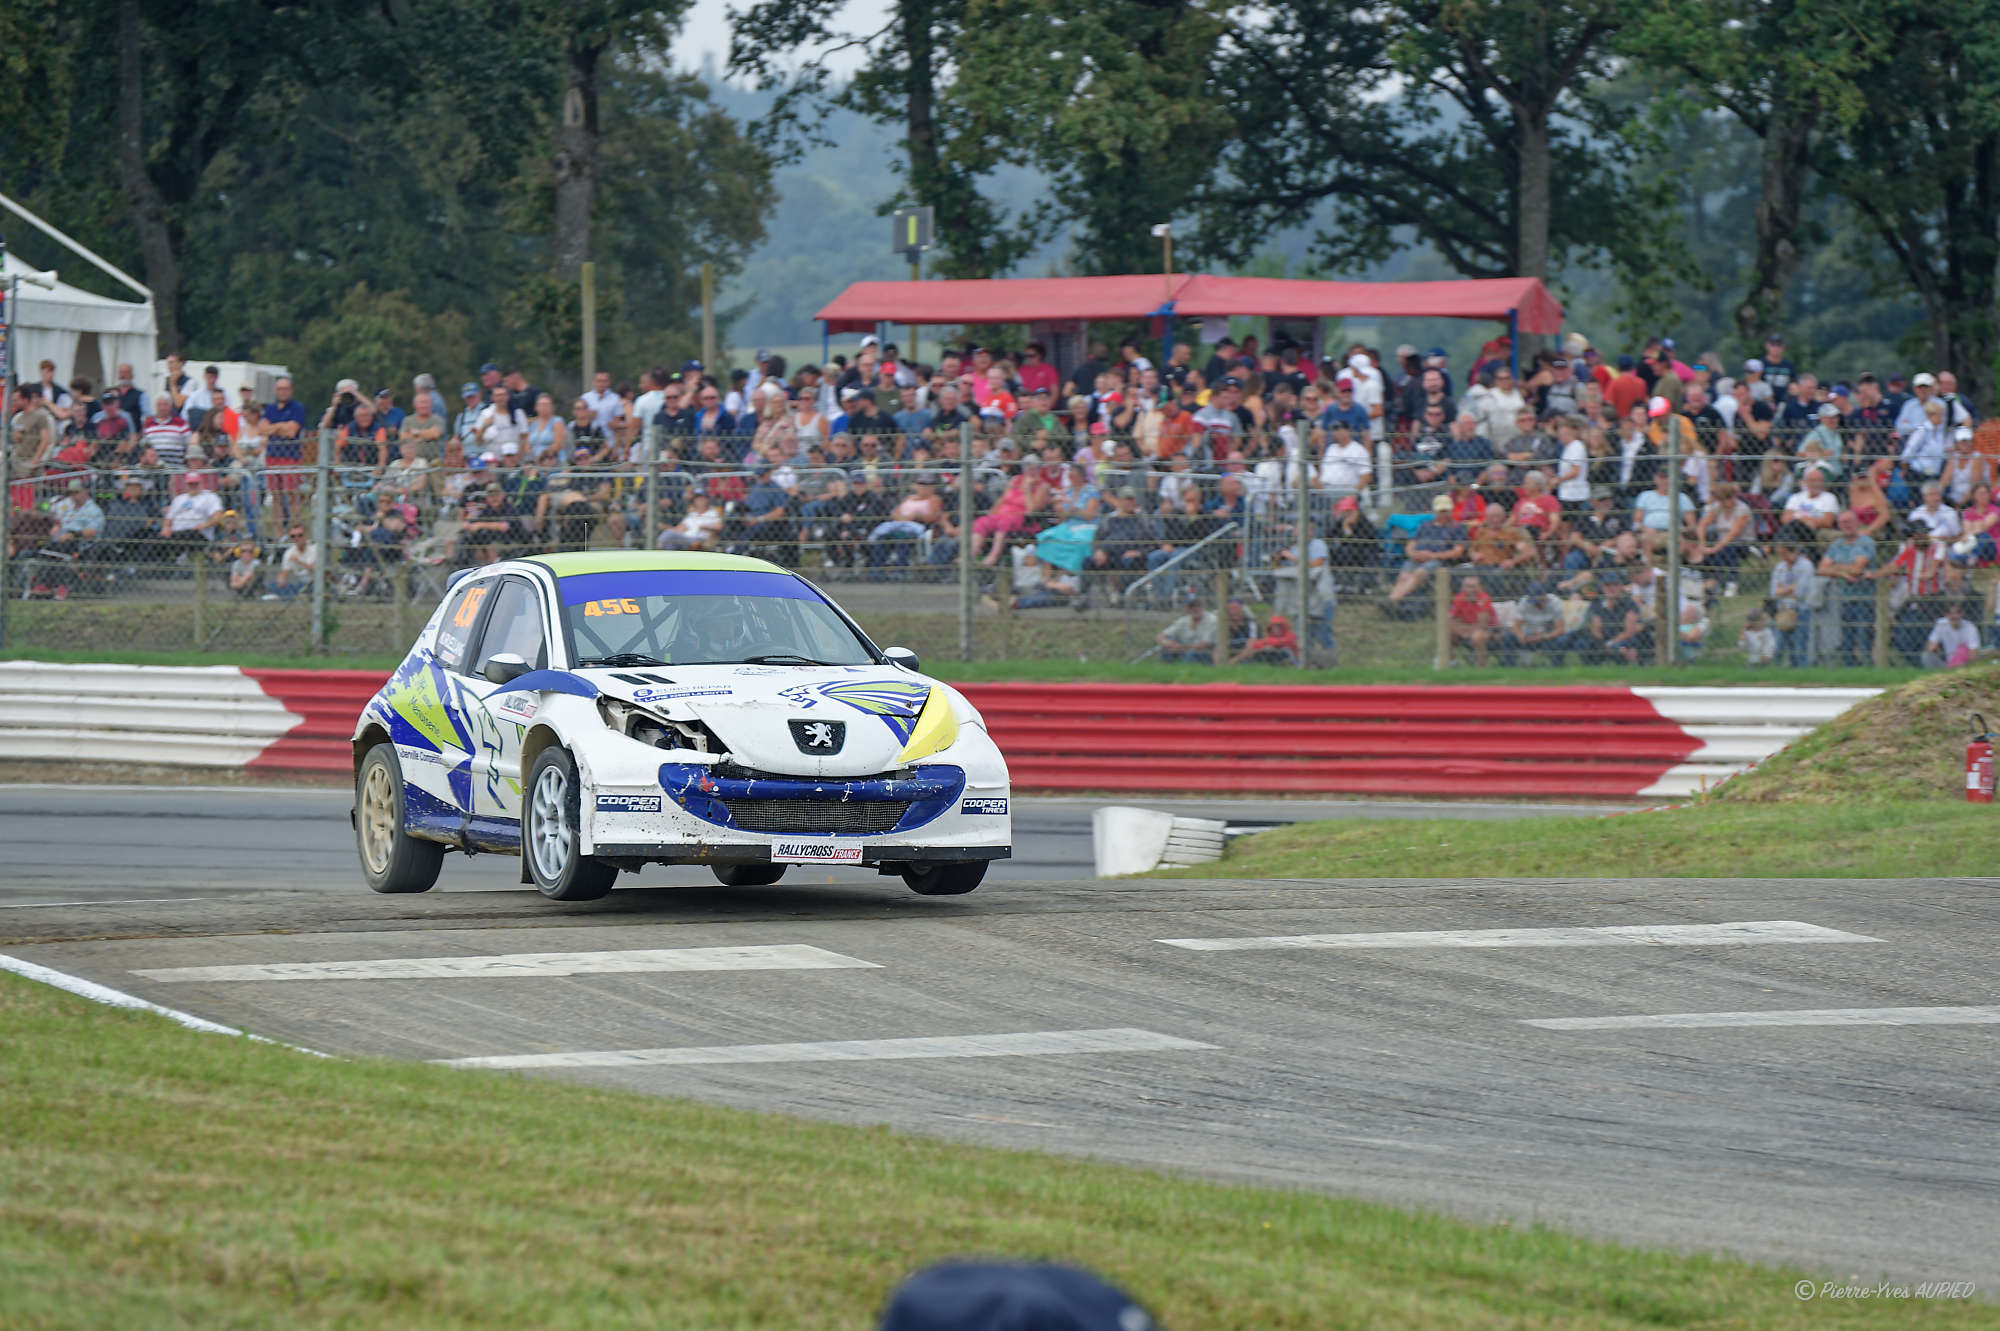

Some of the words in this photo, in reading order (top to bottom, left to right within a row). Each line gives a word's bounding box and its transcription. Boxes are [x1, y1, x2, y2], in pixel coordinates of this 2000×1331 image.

[584, 598, 641, 616] 456
[597, 796, 660, 805] COOPER
[963, 799, 1006, 808] COOPER
[777, 843, 834, 857] RALLYCROSS
[836, 849, 860, 859] FRANCE
